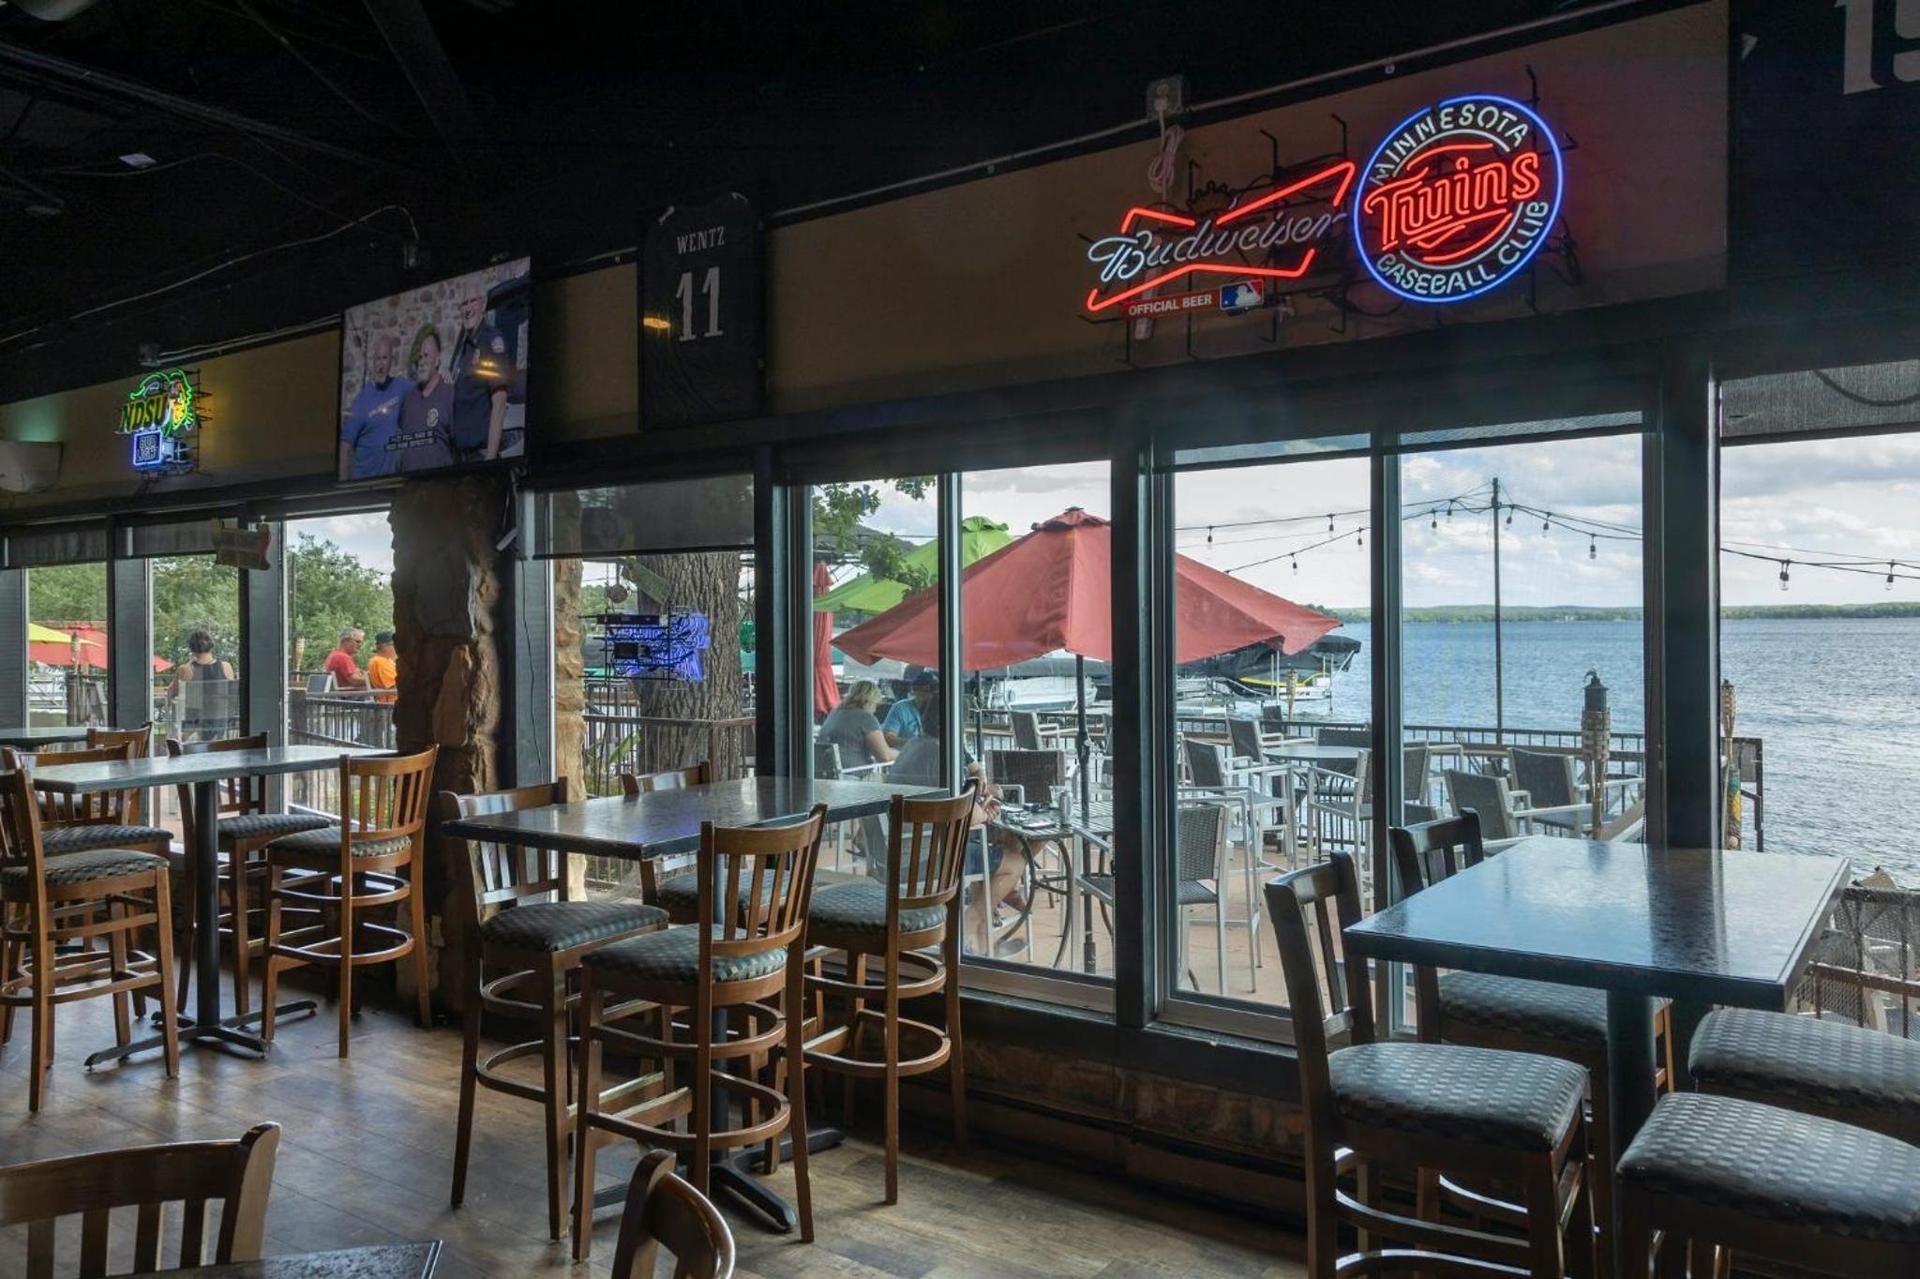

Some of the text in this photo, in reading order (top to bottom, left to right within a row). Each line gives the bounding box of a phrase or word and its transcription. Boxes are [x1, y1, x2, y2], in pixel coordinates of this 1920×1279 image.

[1369, 103, 1528, 186] MINNESOTA
[1364, 151, 1541, 251] Twins
[676, 225, 726, 255] WENTZ
[1087, 211, 1348, 282] Budweiser
[1376, 201, 1549, 295] BASEBALL CLUB
[675, 265, 724, 342] 11
[1128, 294, 1212, 317] OFFICIAL BEER
[119, 393, 169, 434] NDSU
